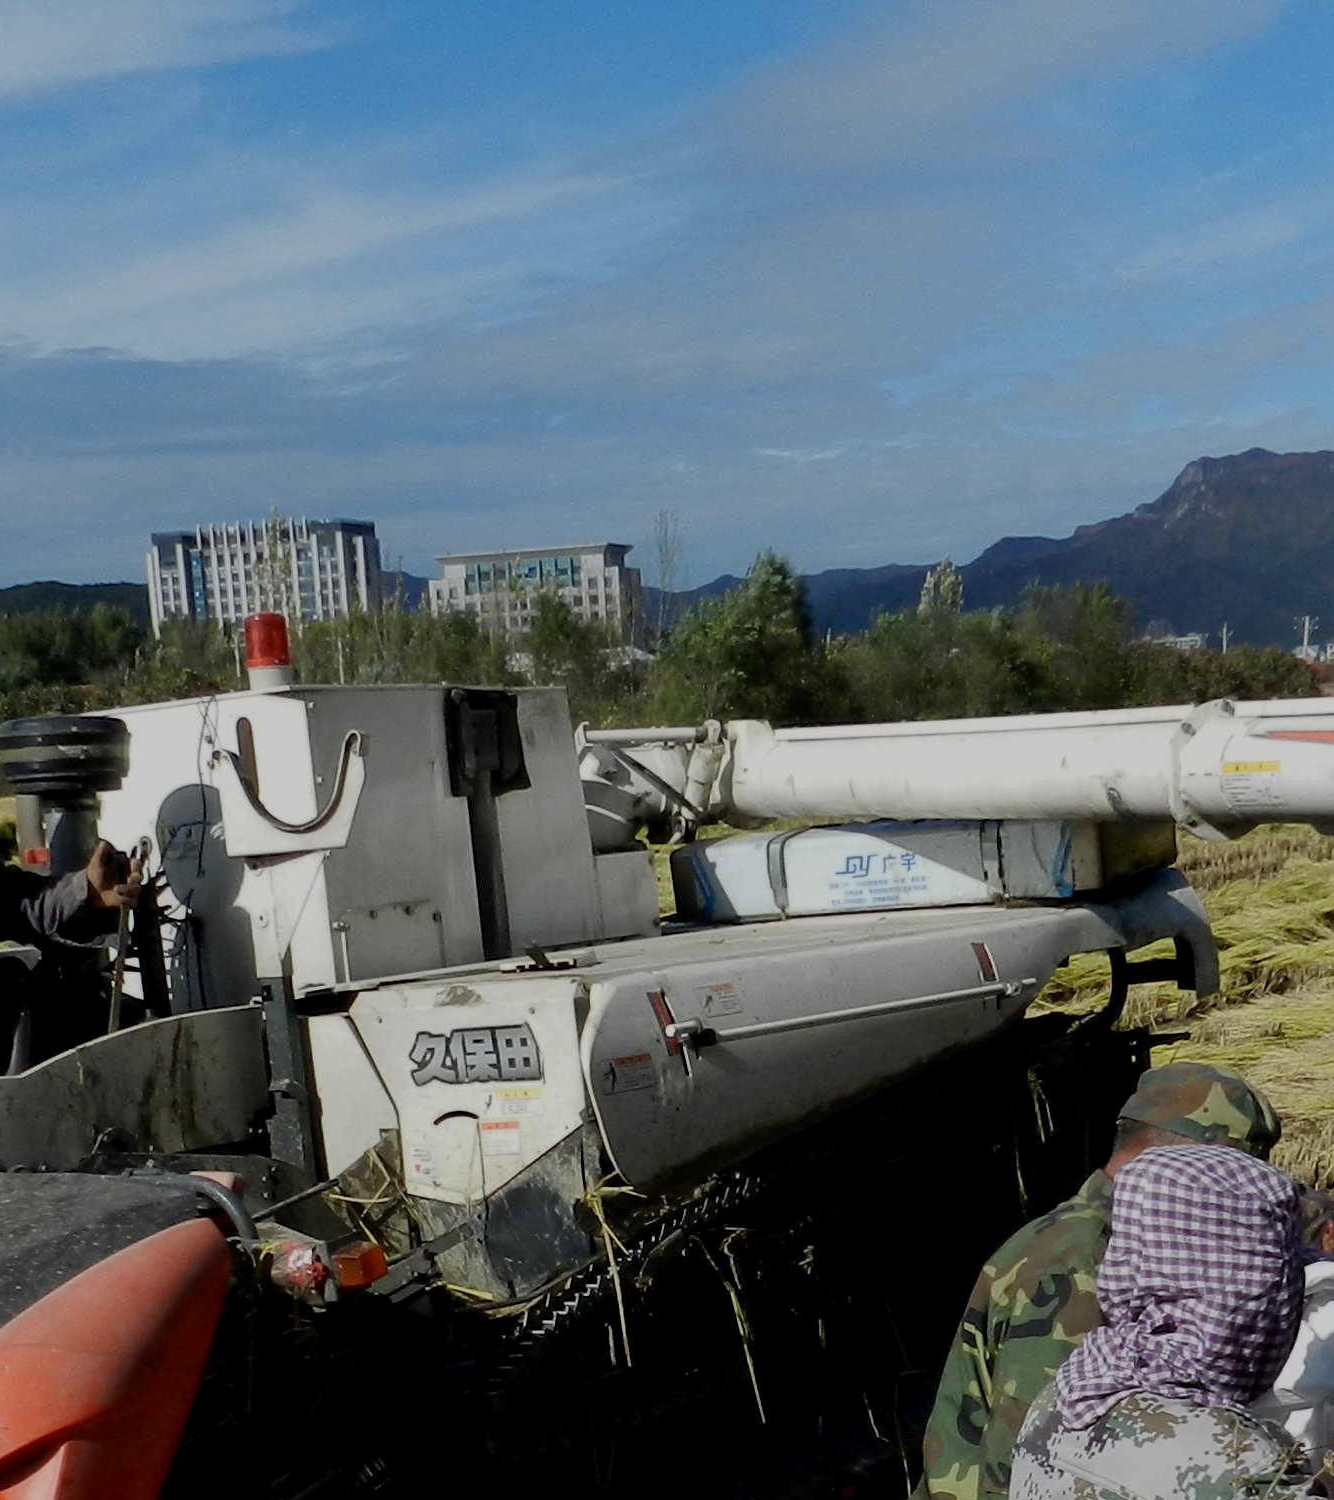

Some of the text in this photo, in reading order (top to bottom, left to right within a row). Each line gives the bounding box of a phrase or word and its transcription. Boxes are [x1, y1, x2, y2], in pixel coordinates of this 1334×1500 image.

[882, 852, 917, 874] 广宇
[409, 1023, 545, 1087] 久保田
